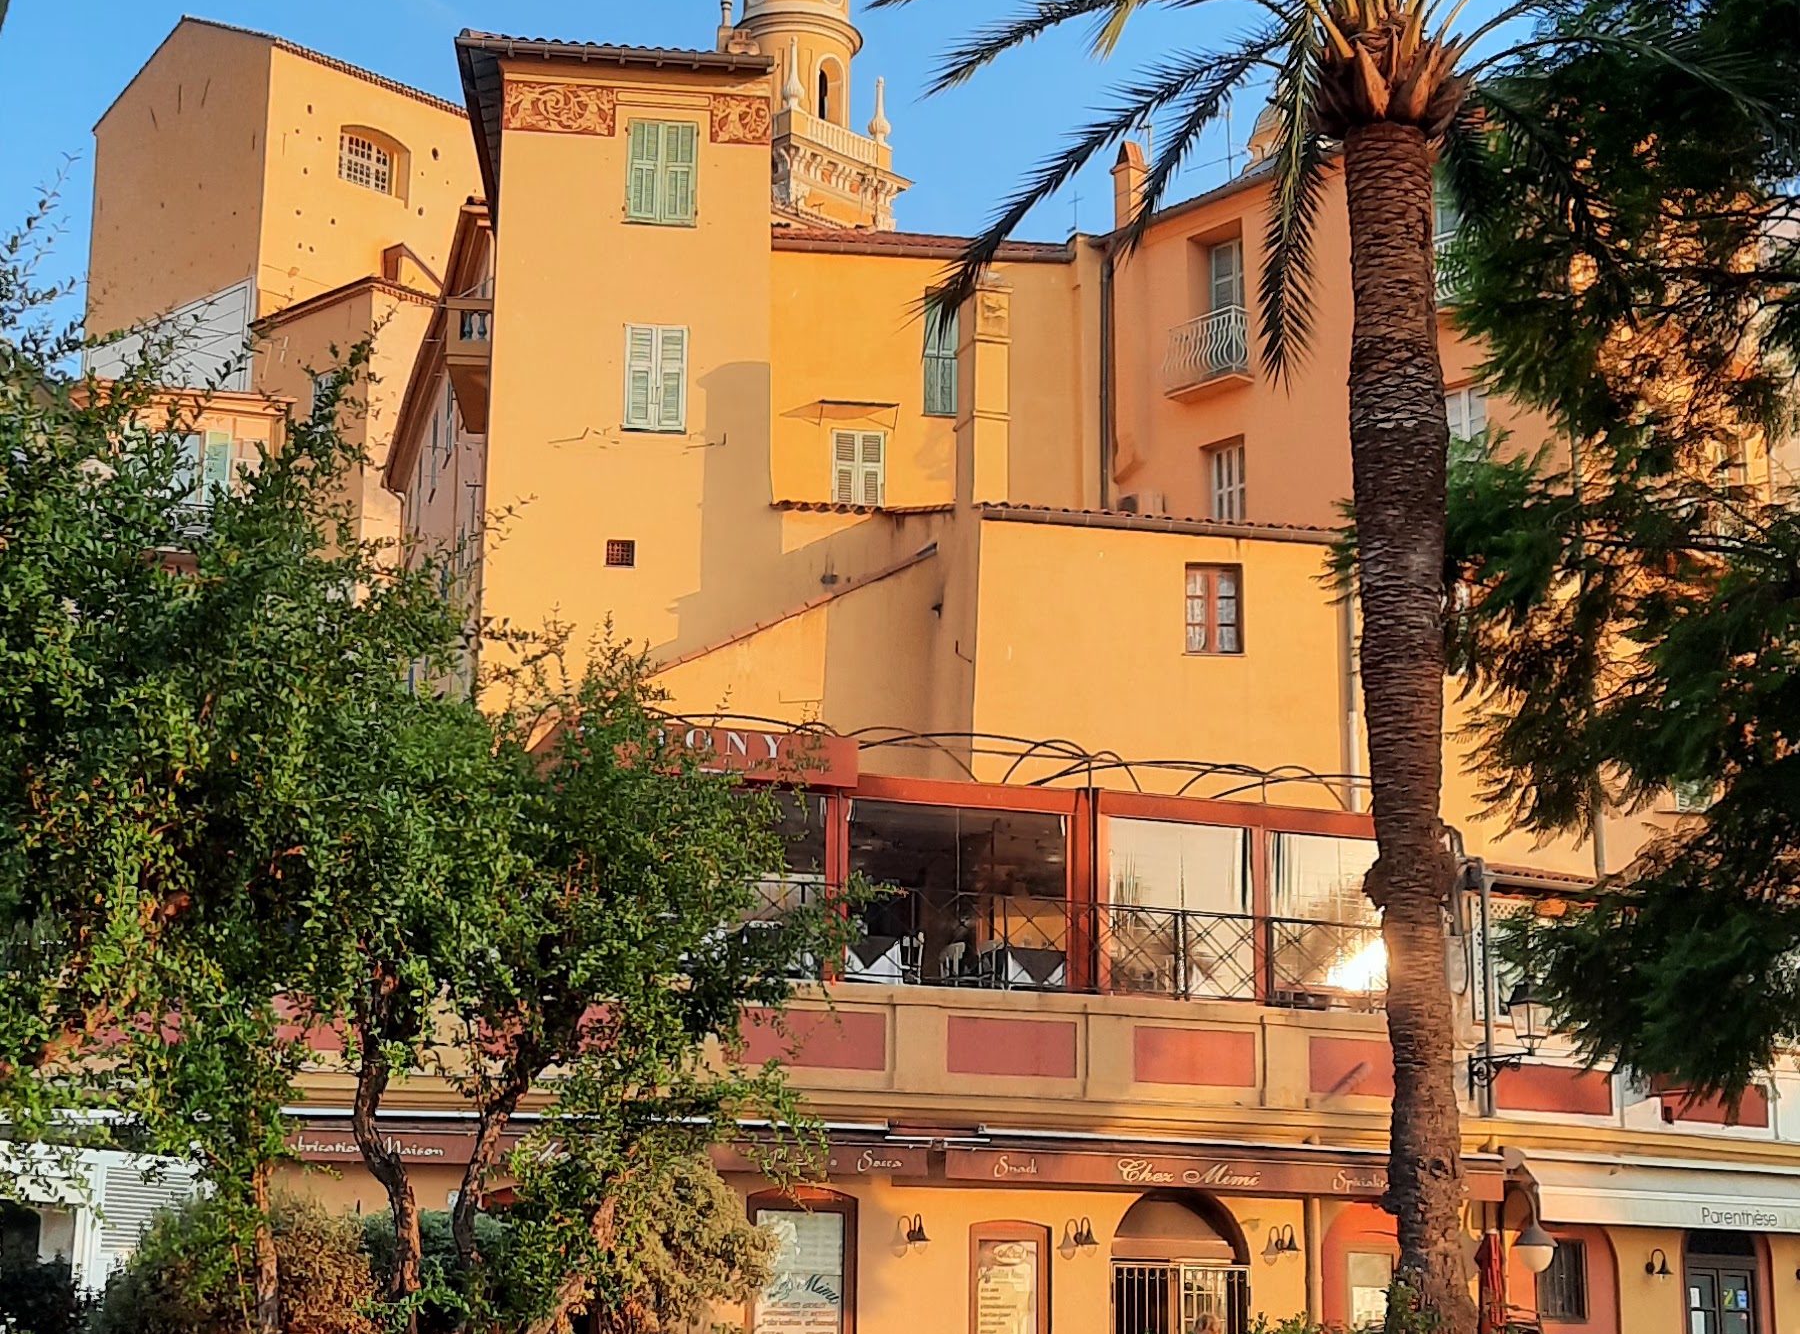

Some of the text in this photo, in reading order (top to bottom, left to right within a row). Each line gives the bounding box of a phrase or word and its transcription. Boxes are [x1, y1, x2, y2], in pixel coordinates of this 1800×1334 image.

[994, 1155, 1038, 1178] Snack
[1117, 1158, 1260, 1186] Chez Mimi
[1701, 1206, 1777, 1227] Parenthèse
